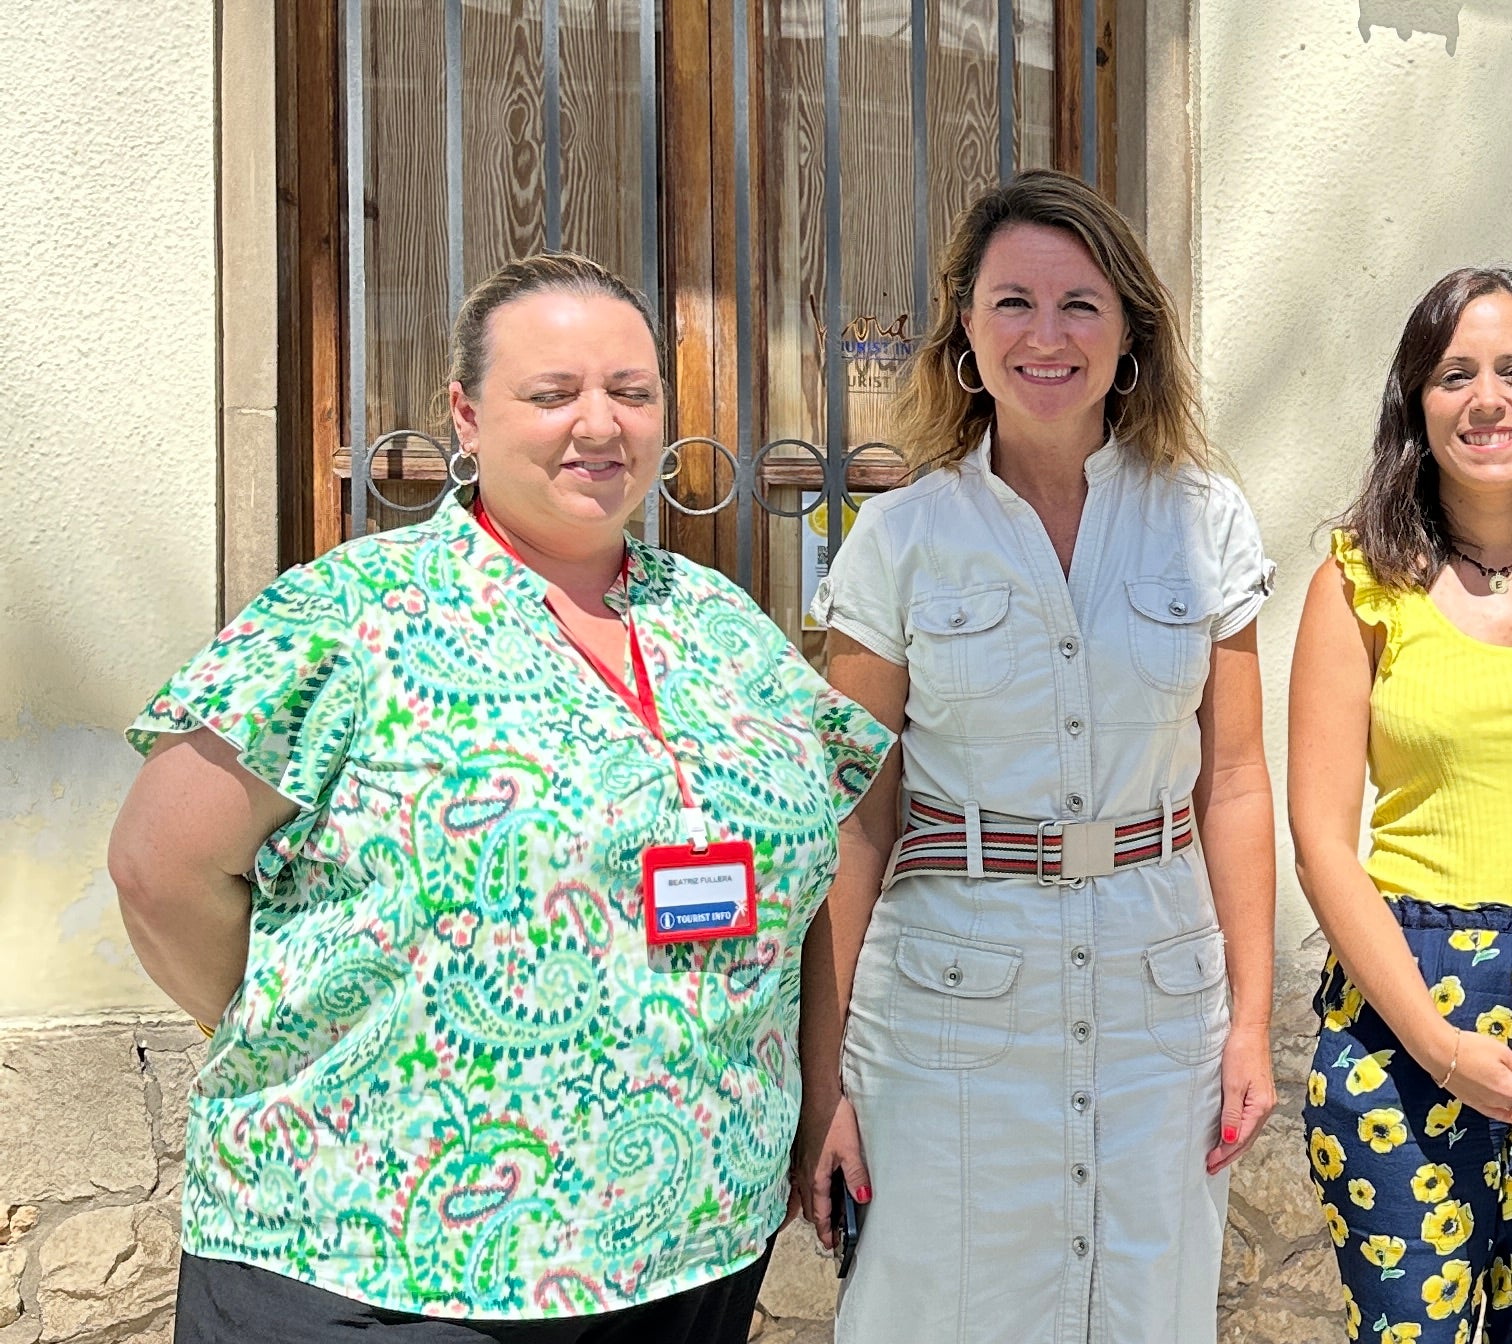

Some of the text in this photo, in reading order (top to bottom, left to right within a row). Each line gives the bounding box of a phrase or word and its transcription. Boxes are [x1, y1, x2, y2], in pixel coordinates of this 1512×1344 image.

[668, 876, 699, 887] BEATRIZ
[676, 910, 732, 925] TOURIST INFO
